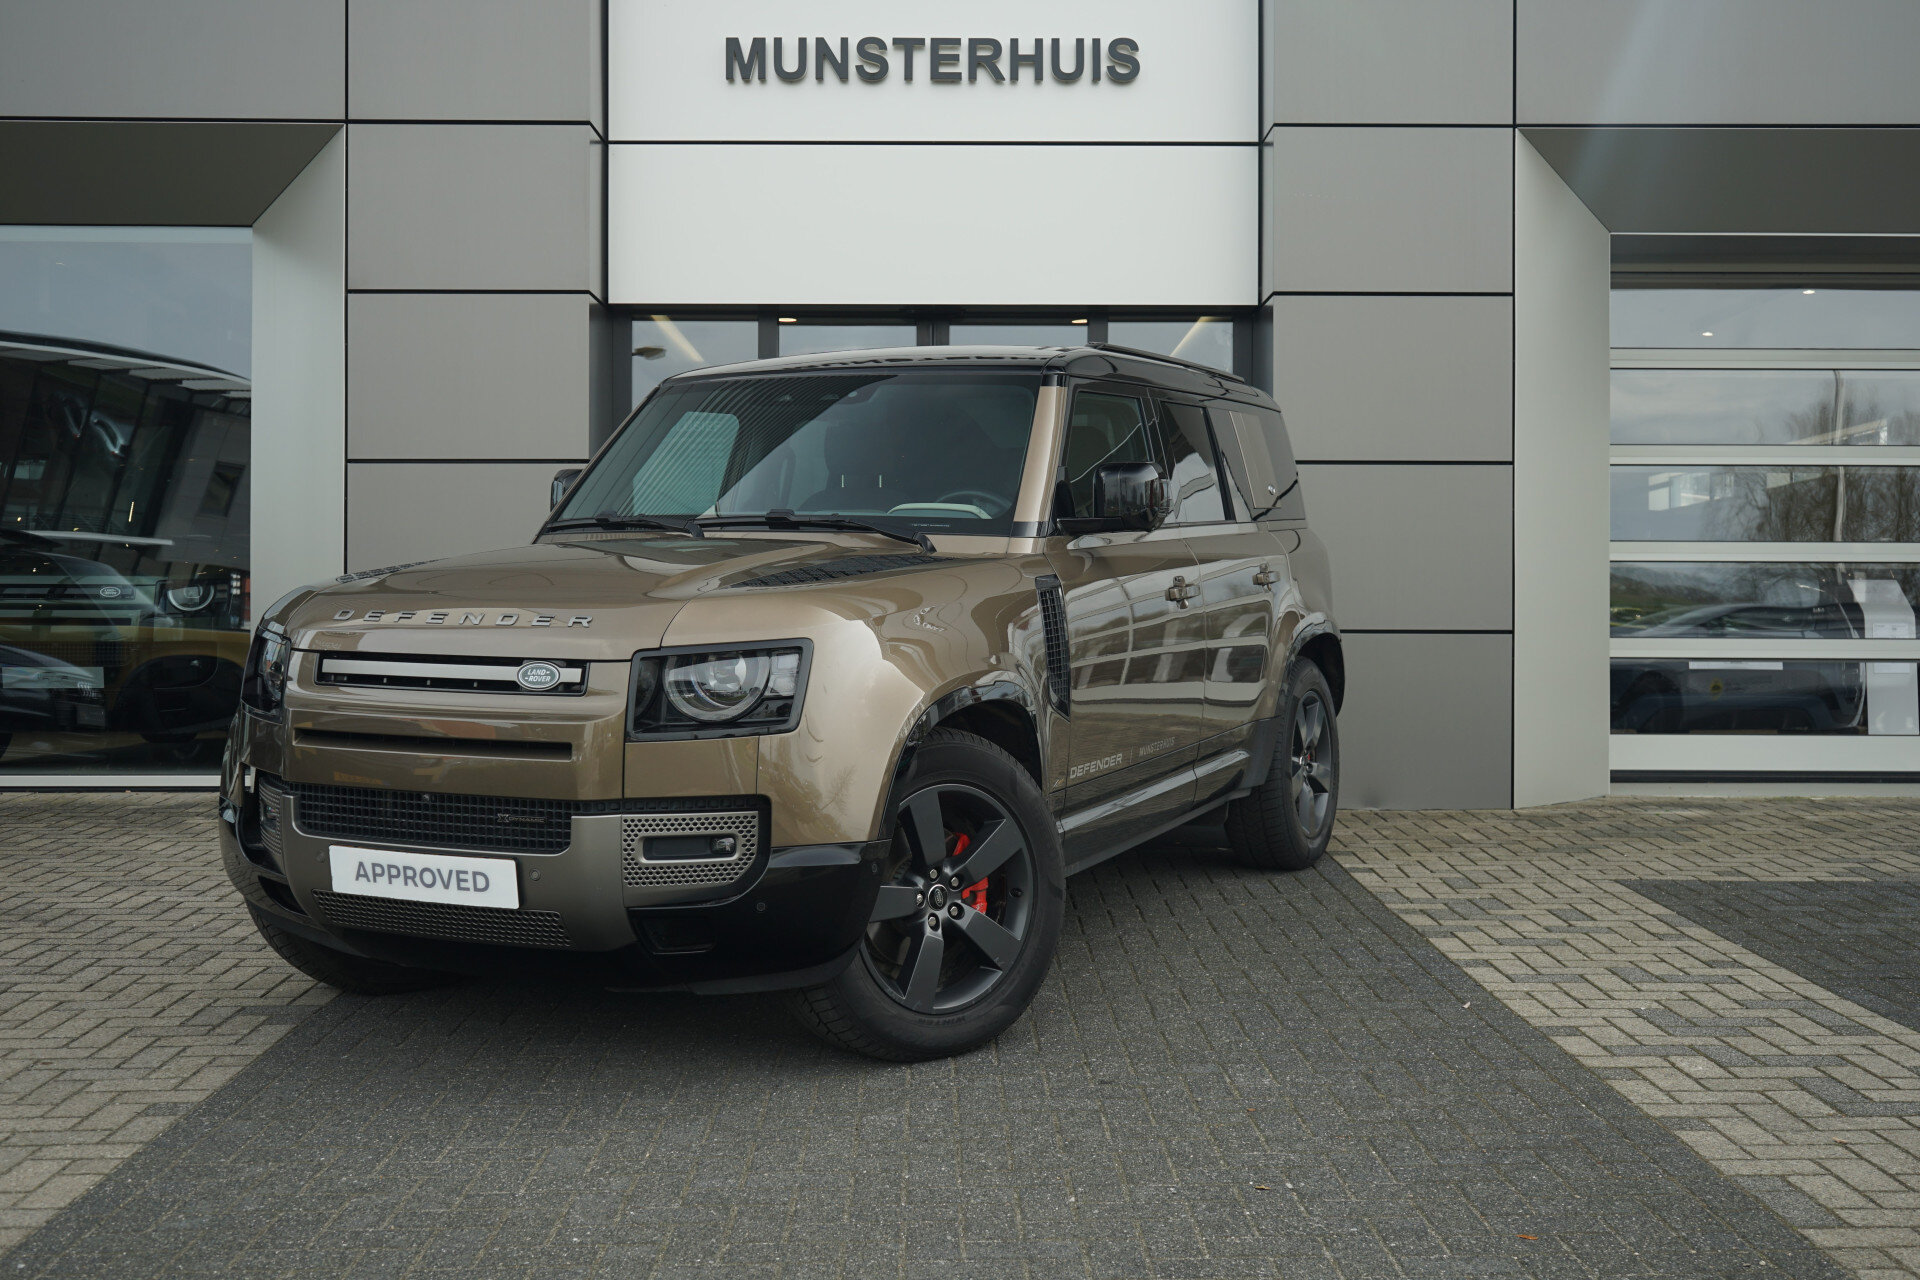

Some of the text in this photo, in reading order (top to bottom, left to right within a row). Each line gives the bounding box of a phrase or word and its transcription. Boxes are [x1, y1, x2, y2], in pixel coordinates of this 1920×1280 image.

[725, 36, 1141, 82] MUNSTERHUIS
[333, 609, 593, 628] DEFENDER
[1070, 753, 1123, 779] DEFENDER
[355, 861, 490, 893] APPROVED
